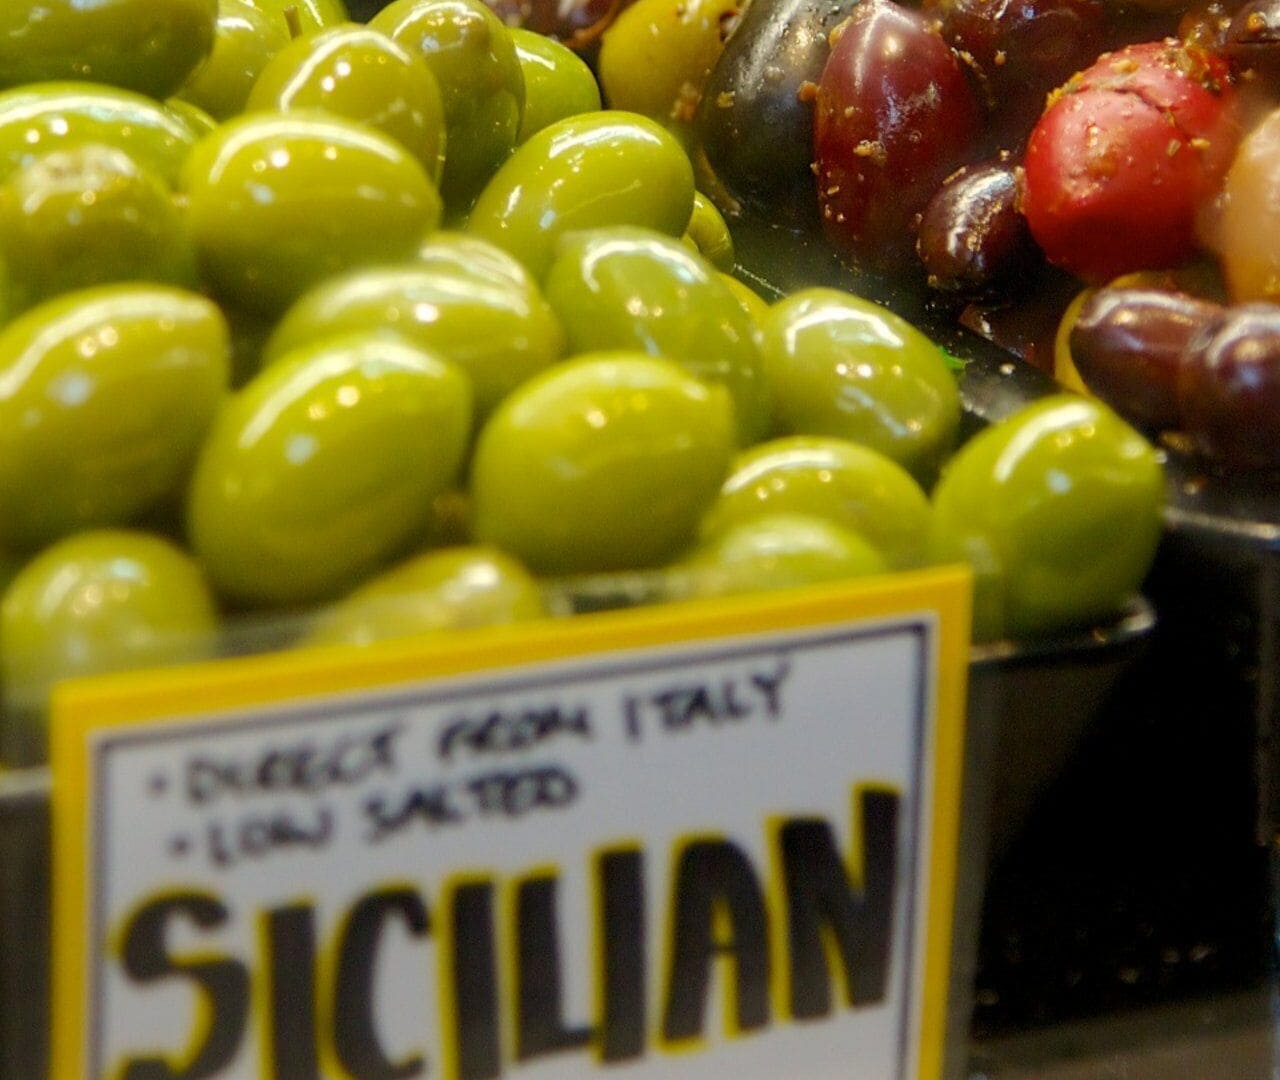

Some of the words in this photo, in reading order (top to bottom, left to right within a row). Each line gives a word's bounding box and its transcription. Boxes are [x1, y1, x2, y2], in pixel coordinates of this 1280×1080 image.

[185, 722, 401, 807] DIRECT
[436, 701, 595, 762] FROM
[622, 659, 793, 742] ITALY
[208, 808, 336, 868] LOW
[361, 763, 580, 845] SALTED
[106, 778, 902, 1080] SICILIAN
